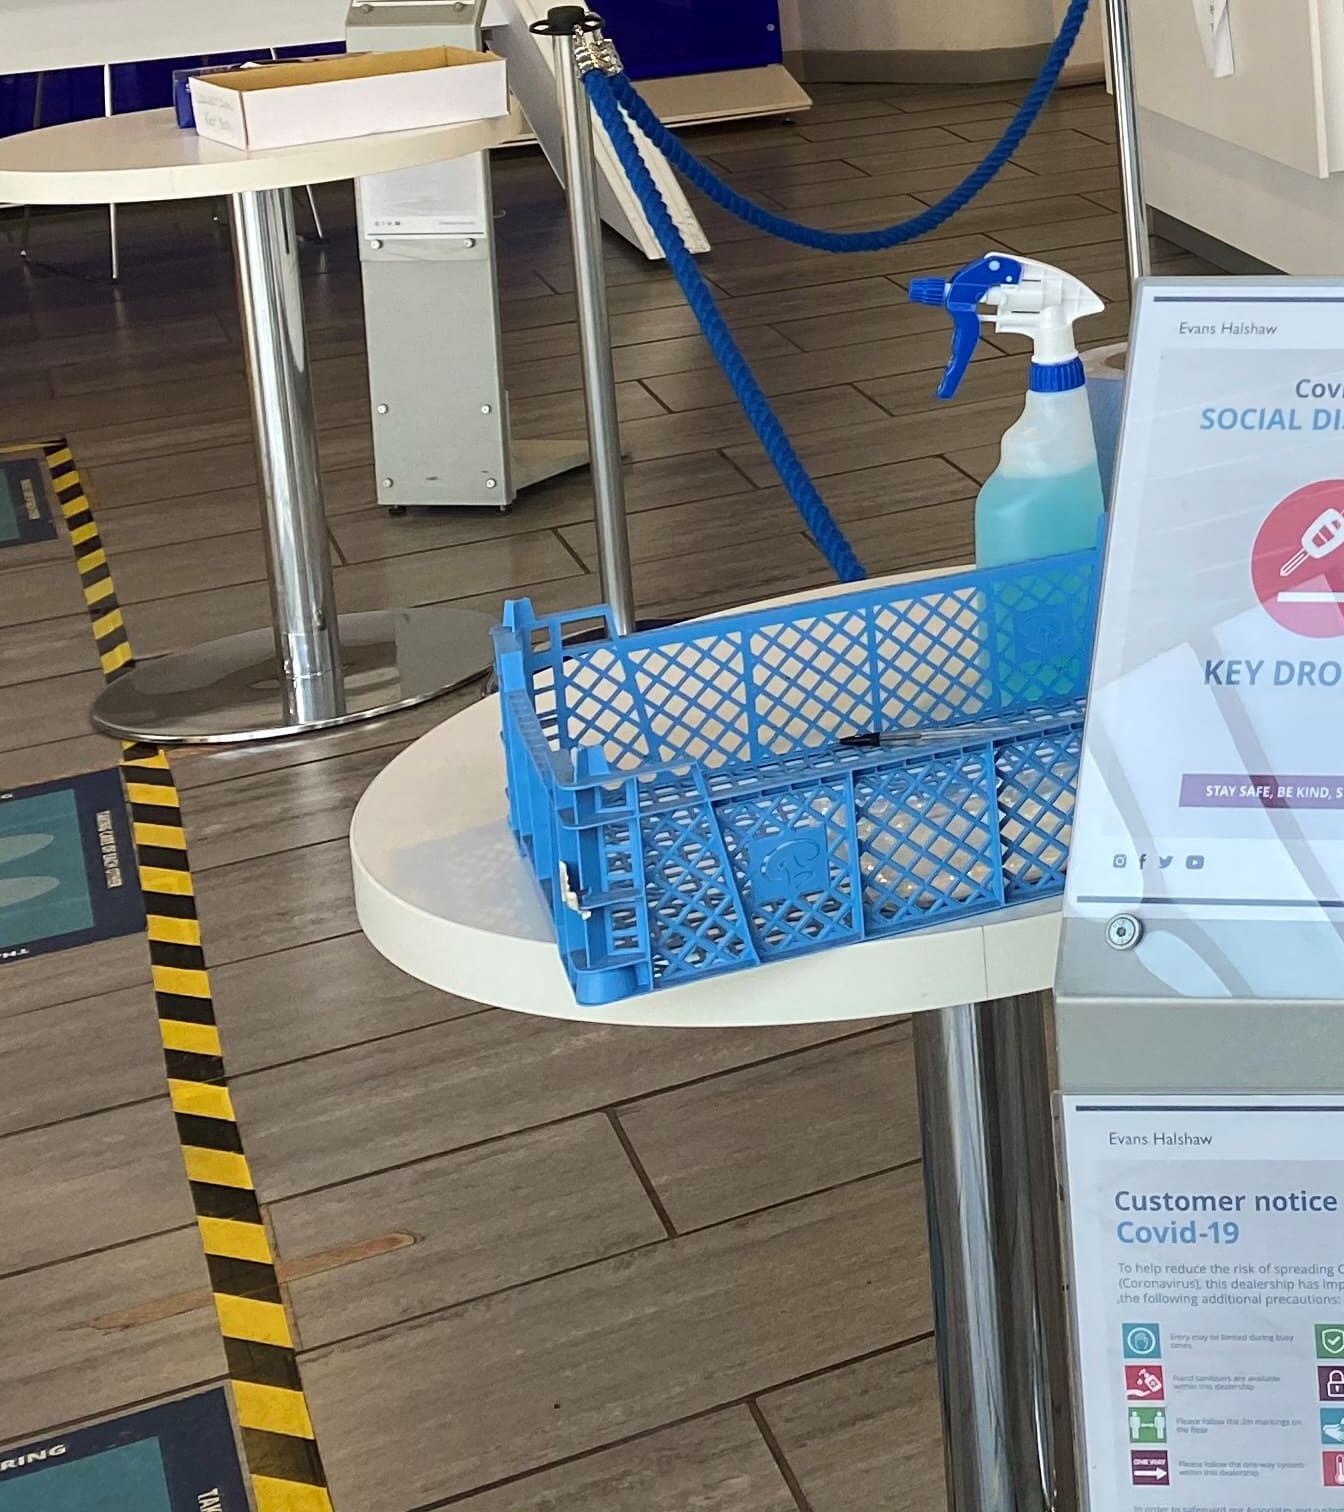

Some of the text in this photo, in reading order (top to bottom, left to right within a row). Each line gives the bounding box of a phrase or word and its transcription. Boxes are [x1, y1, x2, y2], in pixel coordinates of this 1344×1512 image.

[1179, 322, 1277, 336] Evans Halshaw
[1200, 408, 1302, 430] SOCIAL
[1203, 660, 1264, 686] KEY
[1206, 785, 1237, 797] STAY
[1239, 786, 1274, 800] SAFE,
[1277, 786, 1293, 798] BE
[1296, 786, 1332, 800] KIND,
[1109, 1132, 1212, 1146] Evans Halshaw
[1115, 1191, 1338, 1212] Customer notice
[1116, 1222, 1239, 1245] Covid-19
